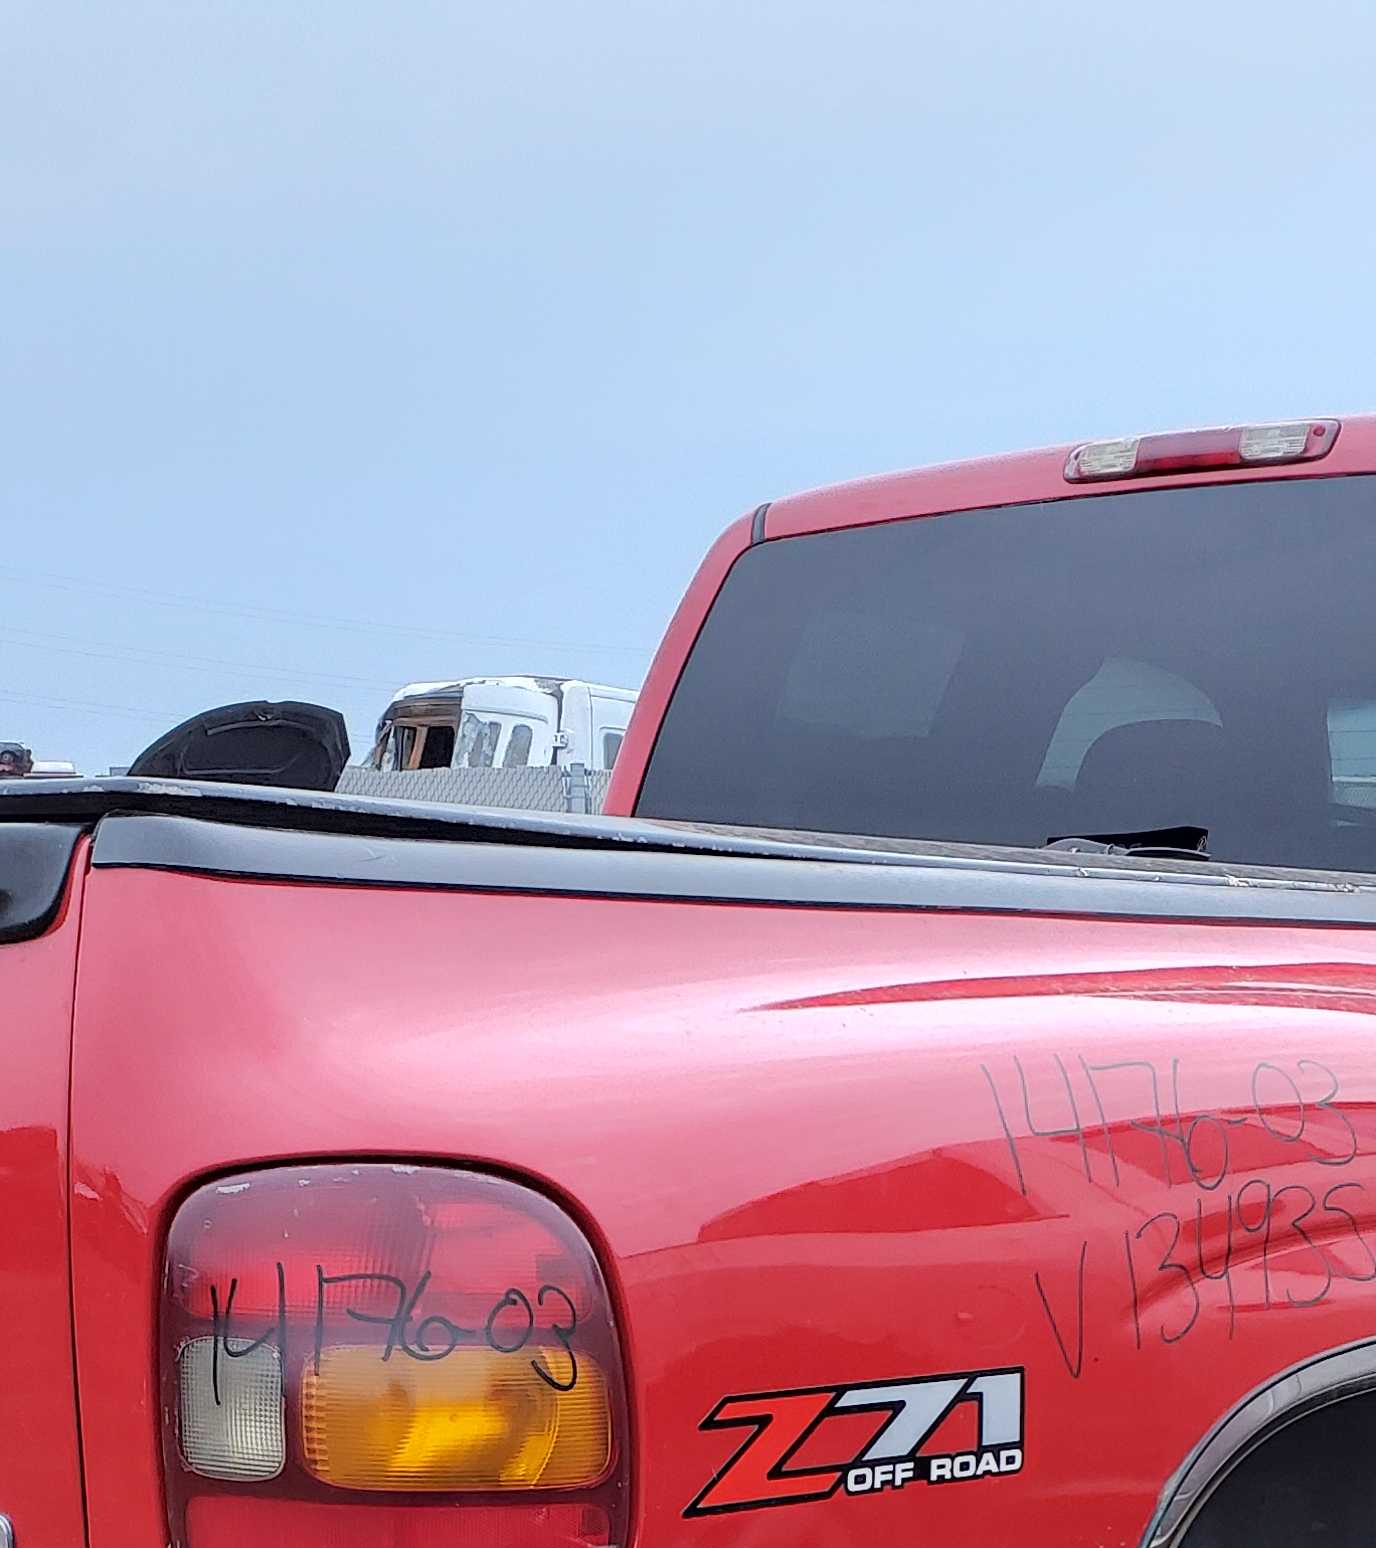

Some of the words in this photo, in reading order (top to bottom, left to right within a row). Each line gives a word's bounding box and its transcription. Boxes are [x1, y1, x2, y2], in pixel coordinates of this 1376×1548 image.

[979, 1053, 1358, 1196] 14176-03
[680, 1365, 1026, 1519] Z71
[846, 1461, 915, 1494] OFF
[929, 1447, 1024, 1482] ROAD
